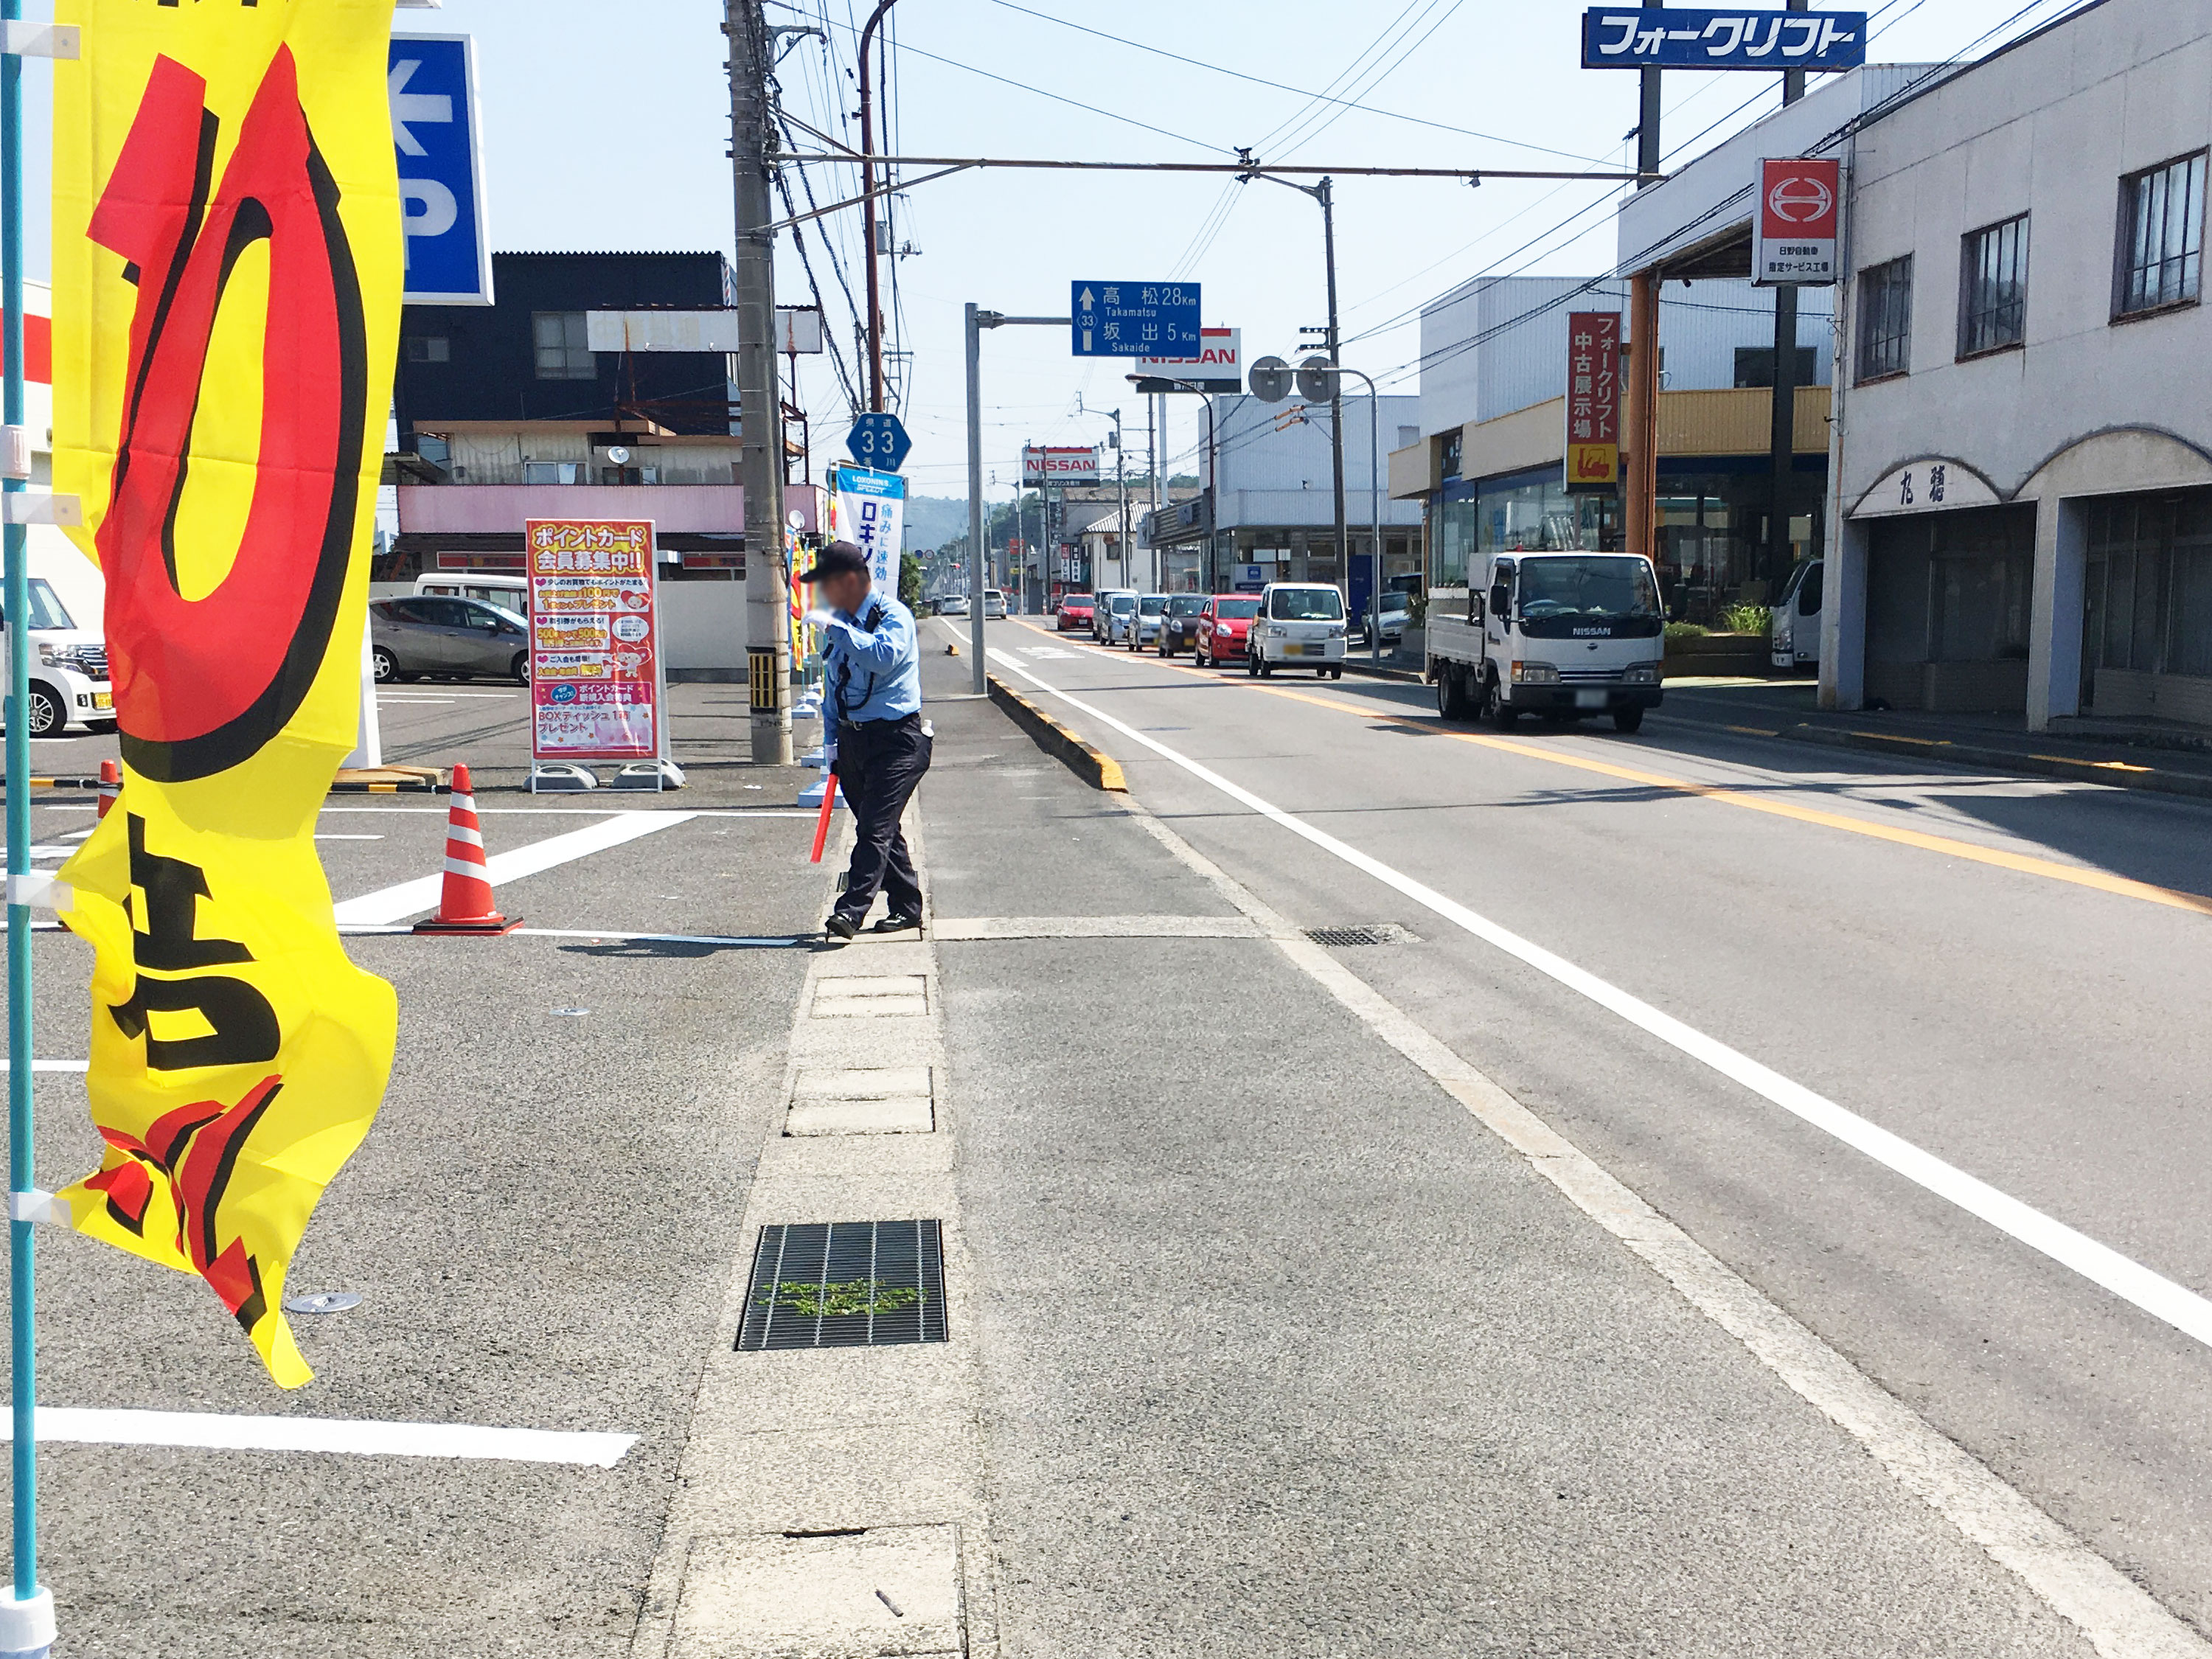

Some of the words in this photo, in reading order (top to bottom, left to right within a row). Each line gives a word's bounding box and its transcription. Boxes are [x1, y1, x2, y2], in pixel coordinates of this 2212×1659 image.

[1599, 15, 1855, 58] フォークリフト
[1779, 246, 1818, 256] 日野自動車
[1769, 262, 1829, 273] 指定サービス工場
[1162, 288, 1181, 306] 28
[1105, 307, 1157, 317] Takamatsu
[1081, 316, 1094, 327] 33
[1167, 323, 1176, 341] 5
[1111, 342, 1150, 352] Sakaide
[1573, 332, 1593, 438] 中古展示場
[1596, 318, 1614, 438] フォークリフト
[862, 431, 894, 454] 33
[1026, 459, 1096, 472] NISSAN
[536, 526, 644, 548] ポイントカード
[874, 503, 893, 581] 痛みに速効
[538, 550, 641, 571] 会員募集中!!
[1573, 627, 1611, 636] NISSAN
[579, 684, 633, 693] ポイントカード
[538, 723, 588, 734] プレゼント
